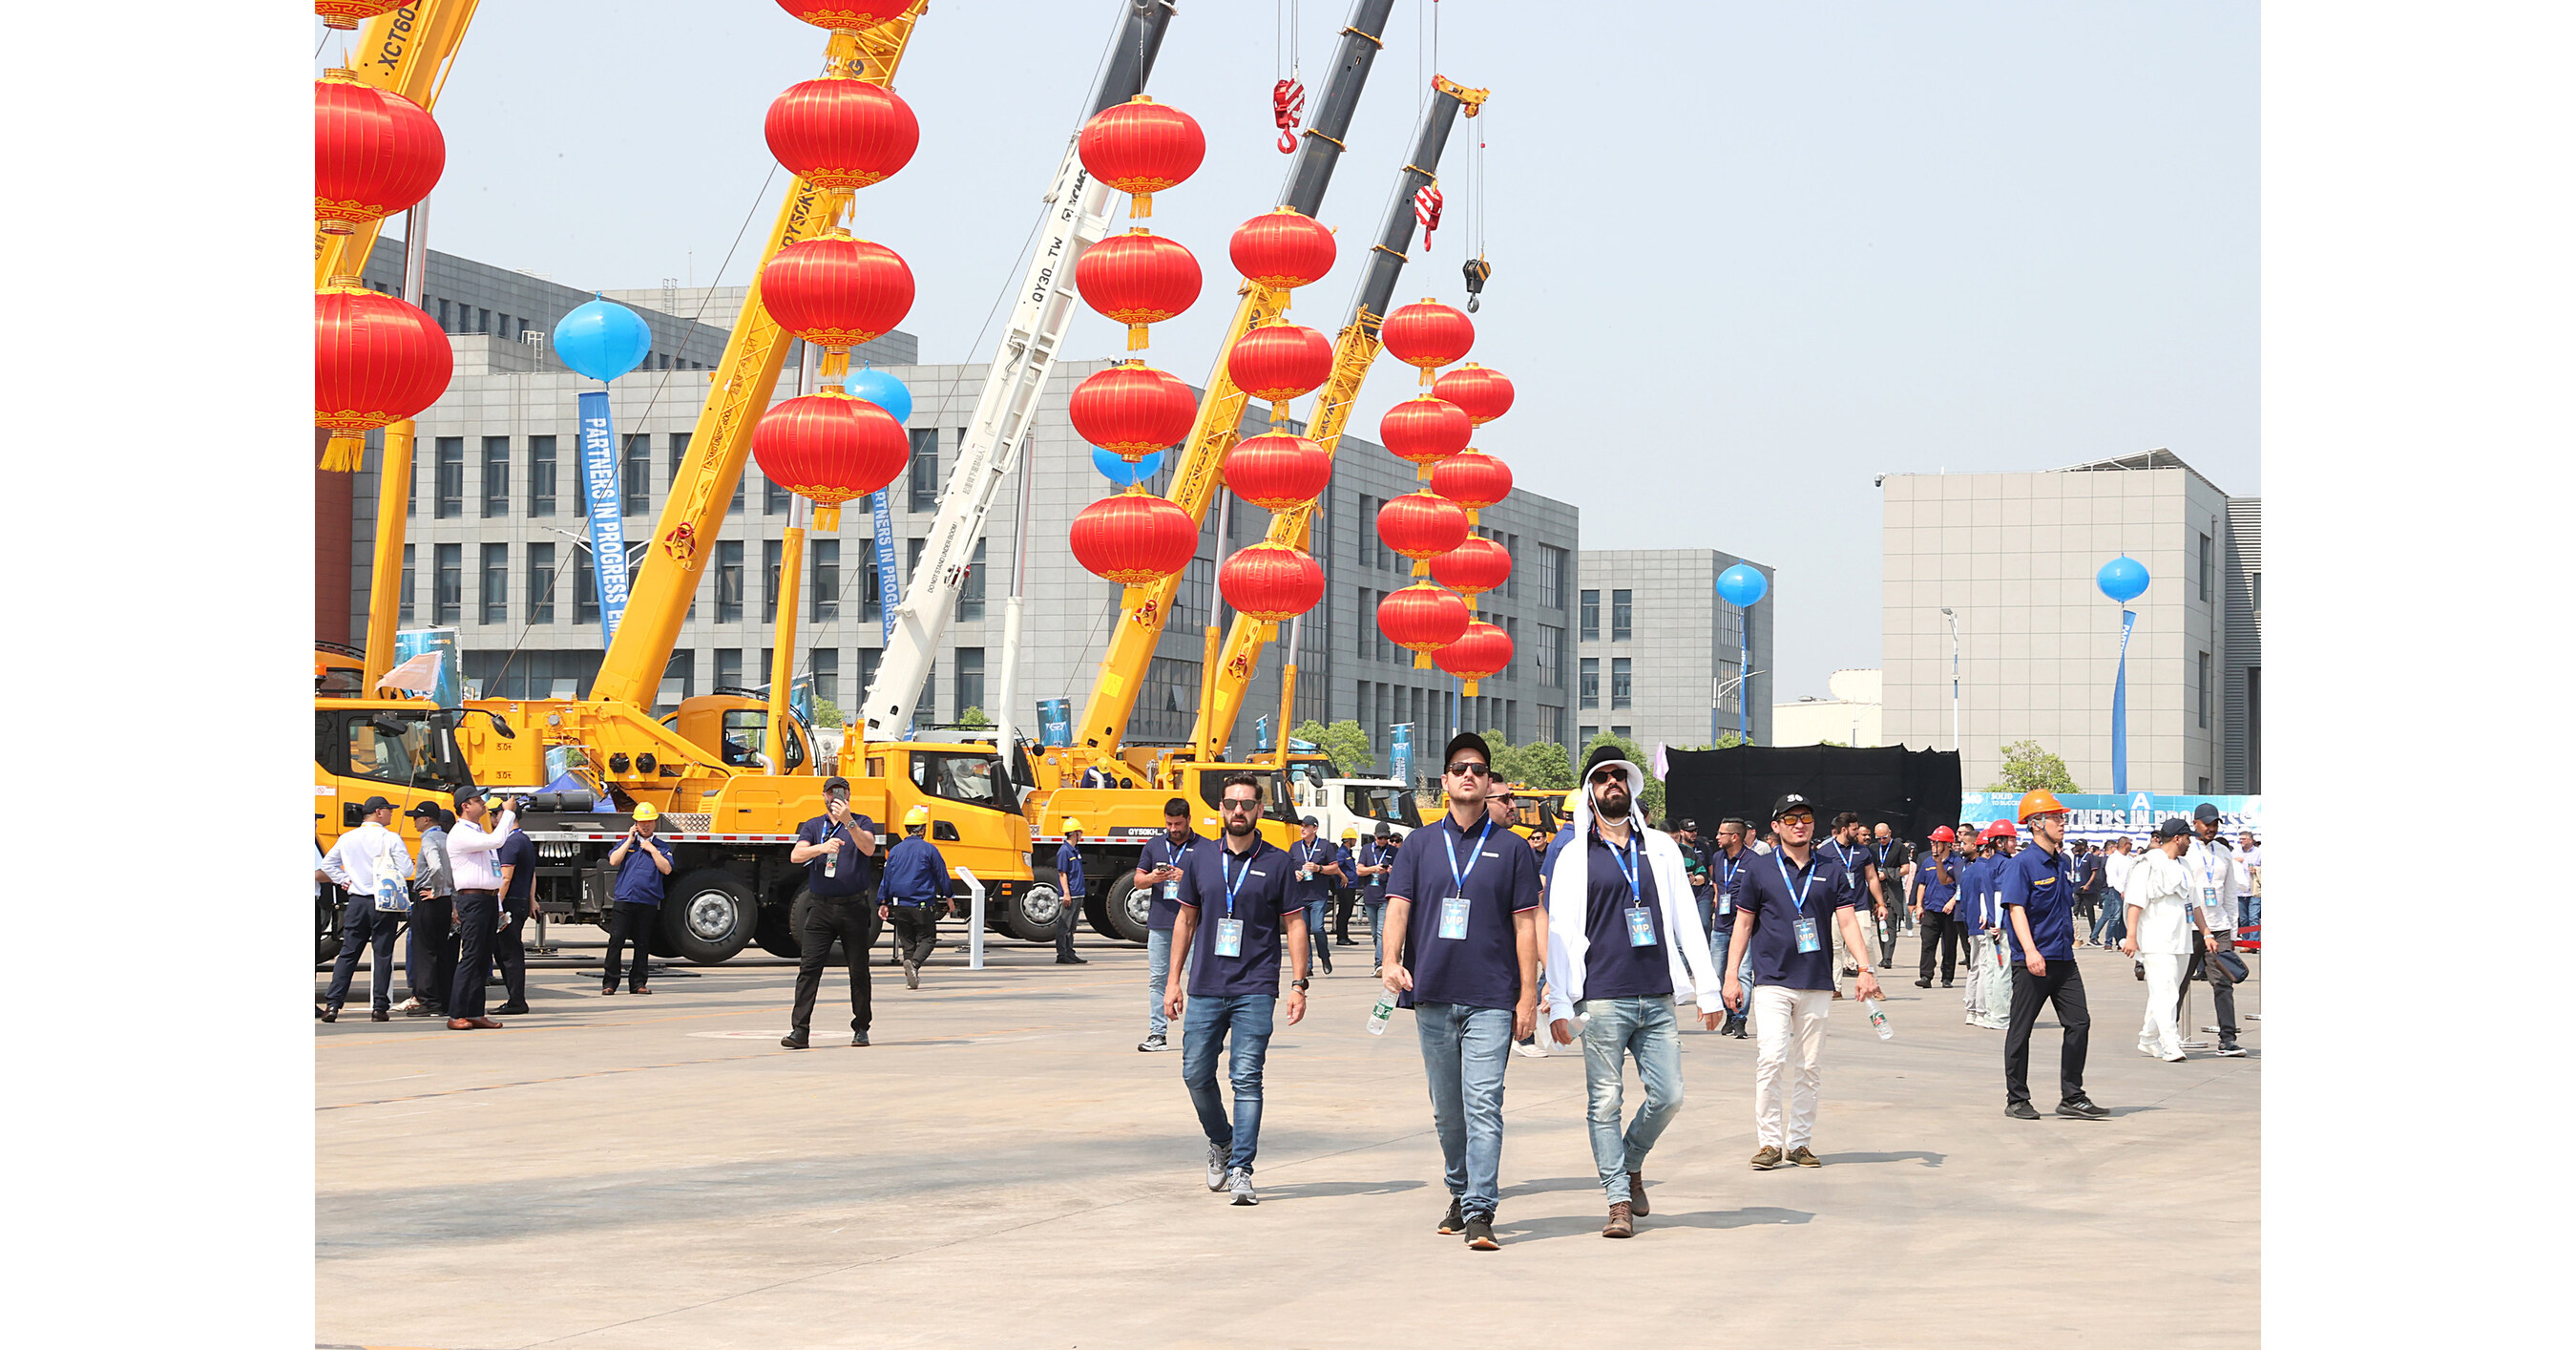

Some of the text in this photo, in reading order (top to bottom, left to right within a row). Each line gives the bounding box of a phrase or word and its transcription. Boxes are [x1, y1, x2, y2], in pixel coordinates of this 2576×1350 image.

[1068, 169, 1088, 205] XCMG
[585, 418, 616, 499] PARTNERS
[593, 502, 618, 518] IN
[940, 538, 952, 558] UNDER
[597, 522, 628, 603] PROGRESS
[875, 491, 899, 637] RTNERS IN PROGRES
[933, 557, 945, 574] STAND
[930, 574, 938, 584] NOT
[927, 583, 934, 593] DO
[2130, 792, 2151, 810] A
[2067, 809, 2126, 825] TNERS
[2129, 810, 2149, 825] IN
[1445, 915, 1464, 925] VIP
[1632, 923, 1649, 934] VIP
[1220, 935, 1238, 943] VIP
[1799, 932, 1814, 942] VIP
